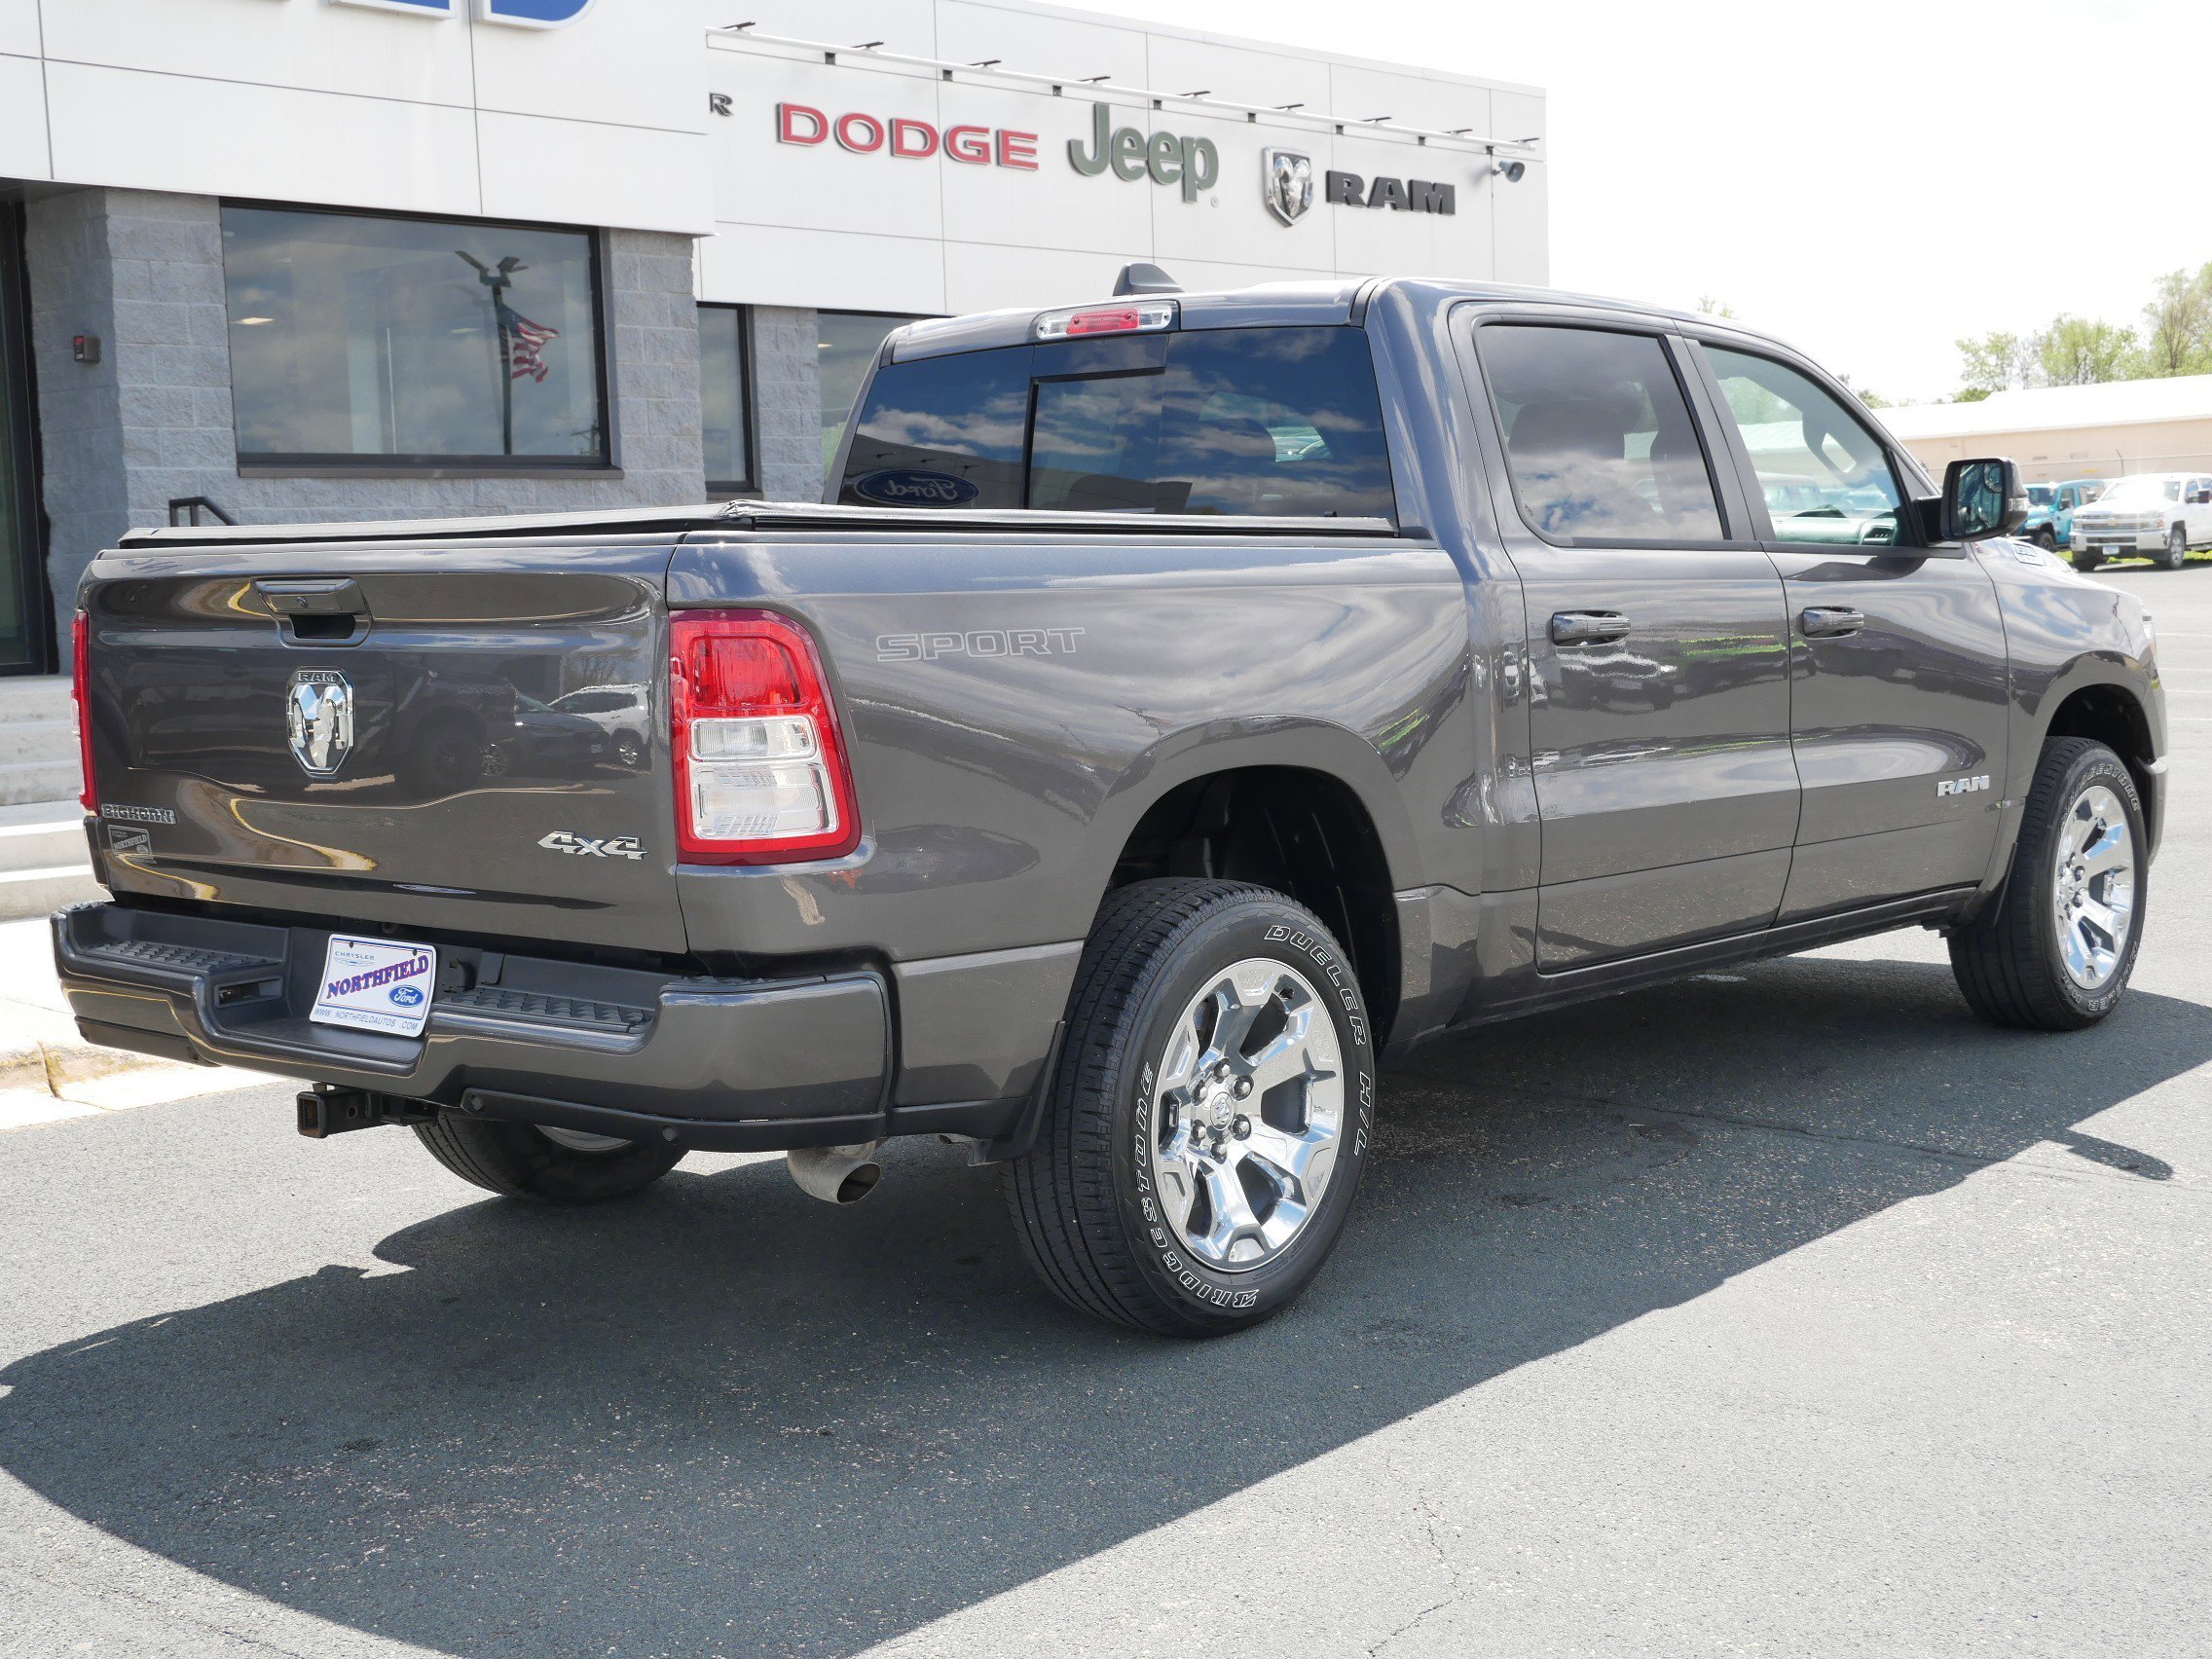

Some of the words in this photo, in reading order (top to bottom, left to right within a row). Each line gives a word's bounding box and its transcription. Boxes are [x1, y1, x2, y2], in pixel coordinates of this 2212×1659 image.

[776, 102, 1039, 170] DODGE
[1068, 102, 1219, 203] Jeep
[1326, 169, 1456, 215] RAM
[876, 627, 1085, 662] SPORT
[298, 672, 337, 682] RAM
[1936, 775, 1990, 797] RAM
[536, 830, 648, 861] 4x4
[334, 950, 375, 961] CHRYSLER
[326, 954, 429, 999] NORTHFIELD
[393, 987, 419, 1005] Ford
[1264, 925, 1367, 1046] DUELER
[1135, 1061, 1260, 1309] BRIDGESTONE
